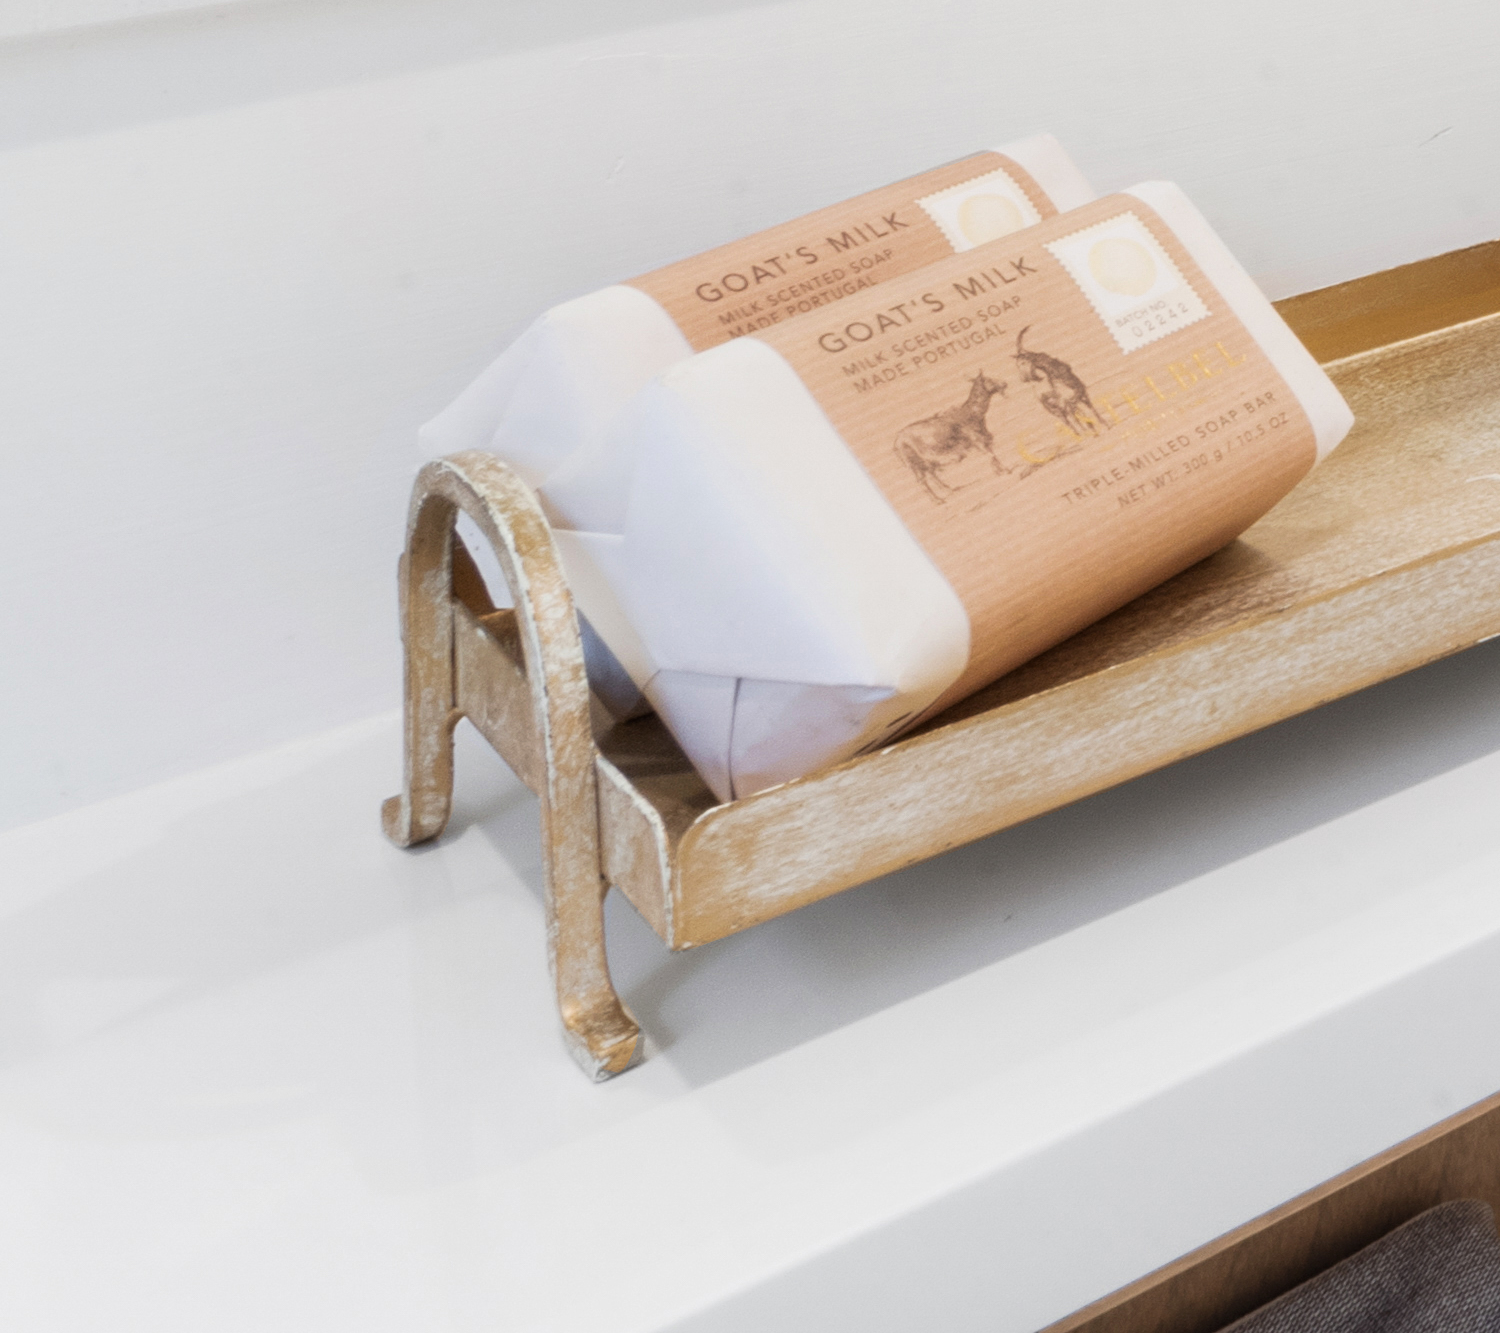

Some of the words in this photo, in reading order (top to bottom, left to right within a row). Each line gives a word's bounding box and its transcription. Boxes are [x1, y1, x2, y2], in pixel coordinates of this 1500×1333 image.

[695, 245, 819, 303] GOAT'S
[825, 211, 910, 253] MILK
[718, 300, 764, 326] MILK
[767, 267, 846, 307] SCENTED
[849, 248, 893, 275] SOAP
[728, 311, 781, 338] MADE
[786, 275, 879, 316] PORTUGAL
[817, 292, 945, 354] GOAT'S
[952, 256, 1038, 301] MILK
[841, 351, 888, 377] MILK
[891, 316, 973, 357] SCENTED
[976, 294, 1022, 323] SOAP
[1114, 308, 1149, 328] BATCH
[852, 362, 910, 393] MADE
[911, 323, 1006, 368] PORTUGAL
[1061, 434, 1191, 506] TRIPLE-MILLED
[1194, 408, 1239, 440] SOAP
[1242, 390, 1278, 415] BAR
[1117, 487, 1148, 509] NET
[1182, 451, 1209, 476] 300
[1213, 447, 1223, 462] g
[1236, 421, 1266, 445] 10.5
[1268, 411, 1290, 429] OZ
